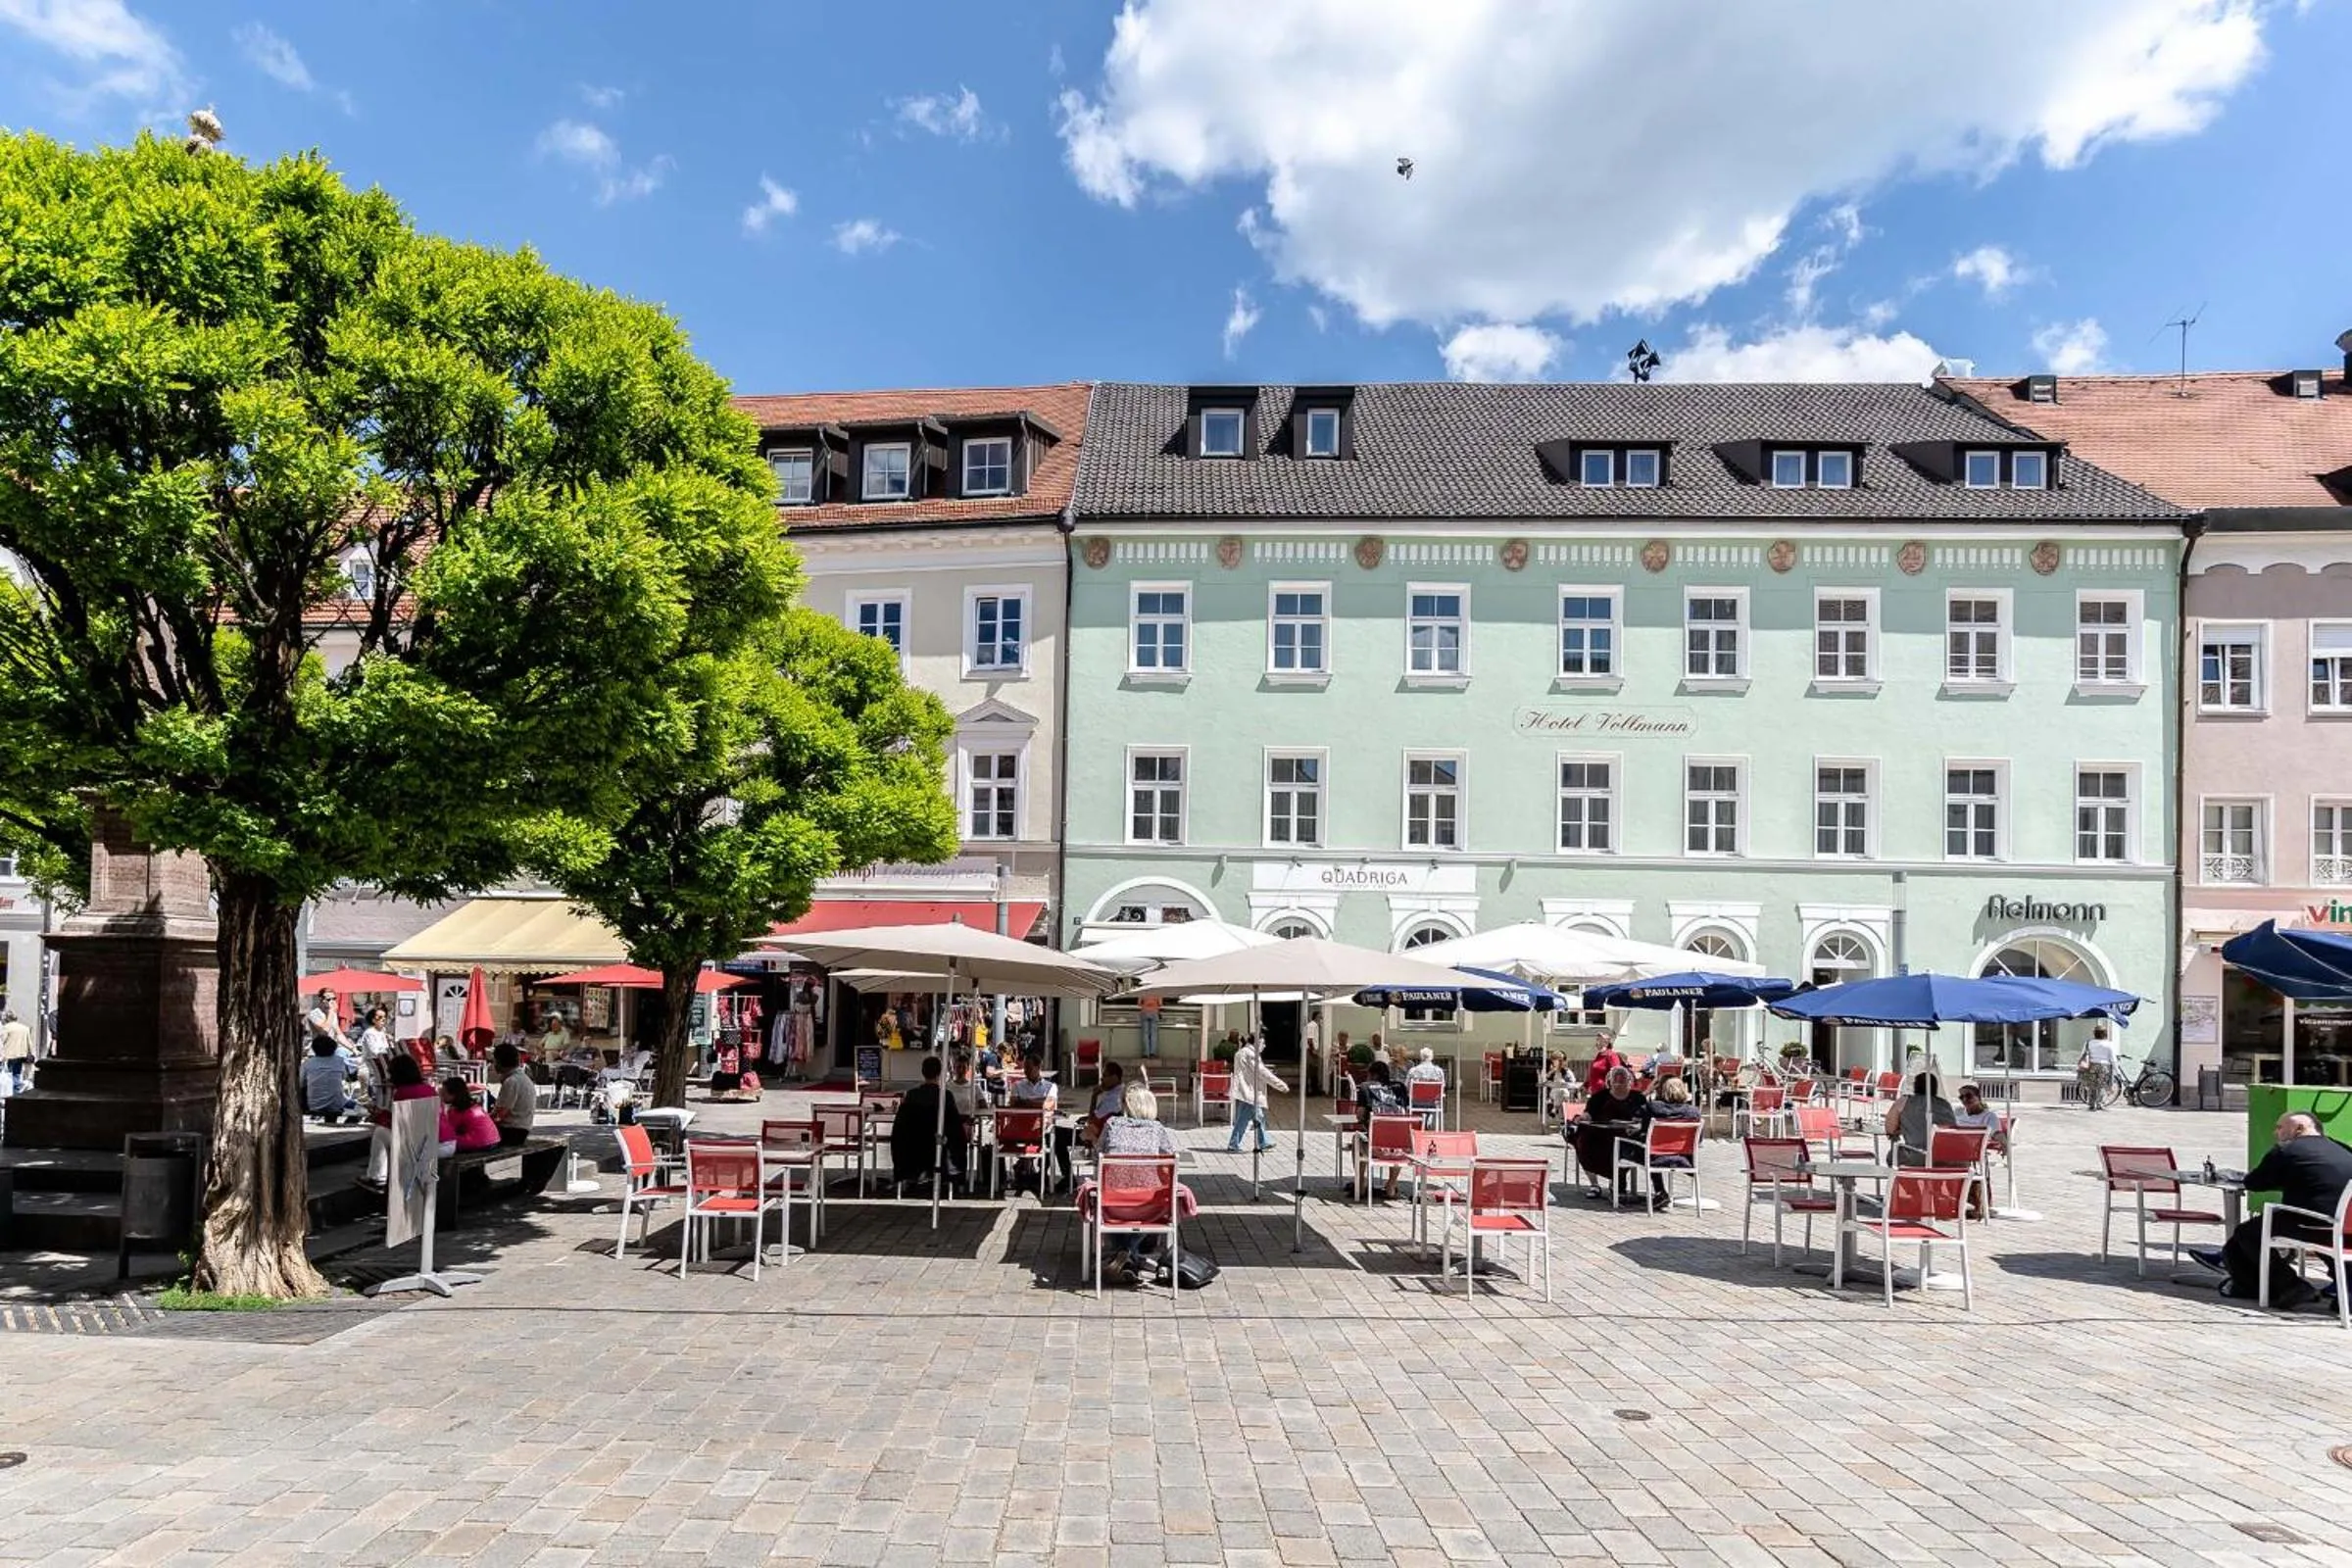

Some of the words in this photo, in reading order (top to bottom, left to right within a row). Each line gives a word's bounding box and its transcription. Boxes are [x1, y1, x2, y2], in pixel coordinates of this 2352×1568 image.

[1521, 710, 1590, 730] Hotel
[1594, 712, 1689, 733] Vollmann
[1321, 868, 1407, 885] QUADRIGA
[1401, 991, 1453, 1002] PAULANER
[1643, 987, 1704, 997] PAULANER
